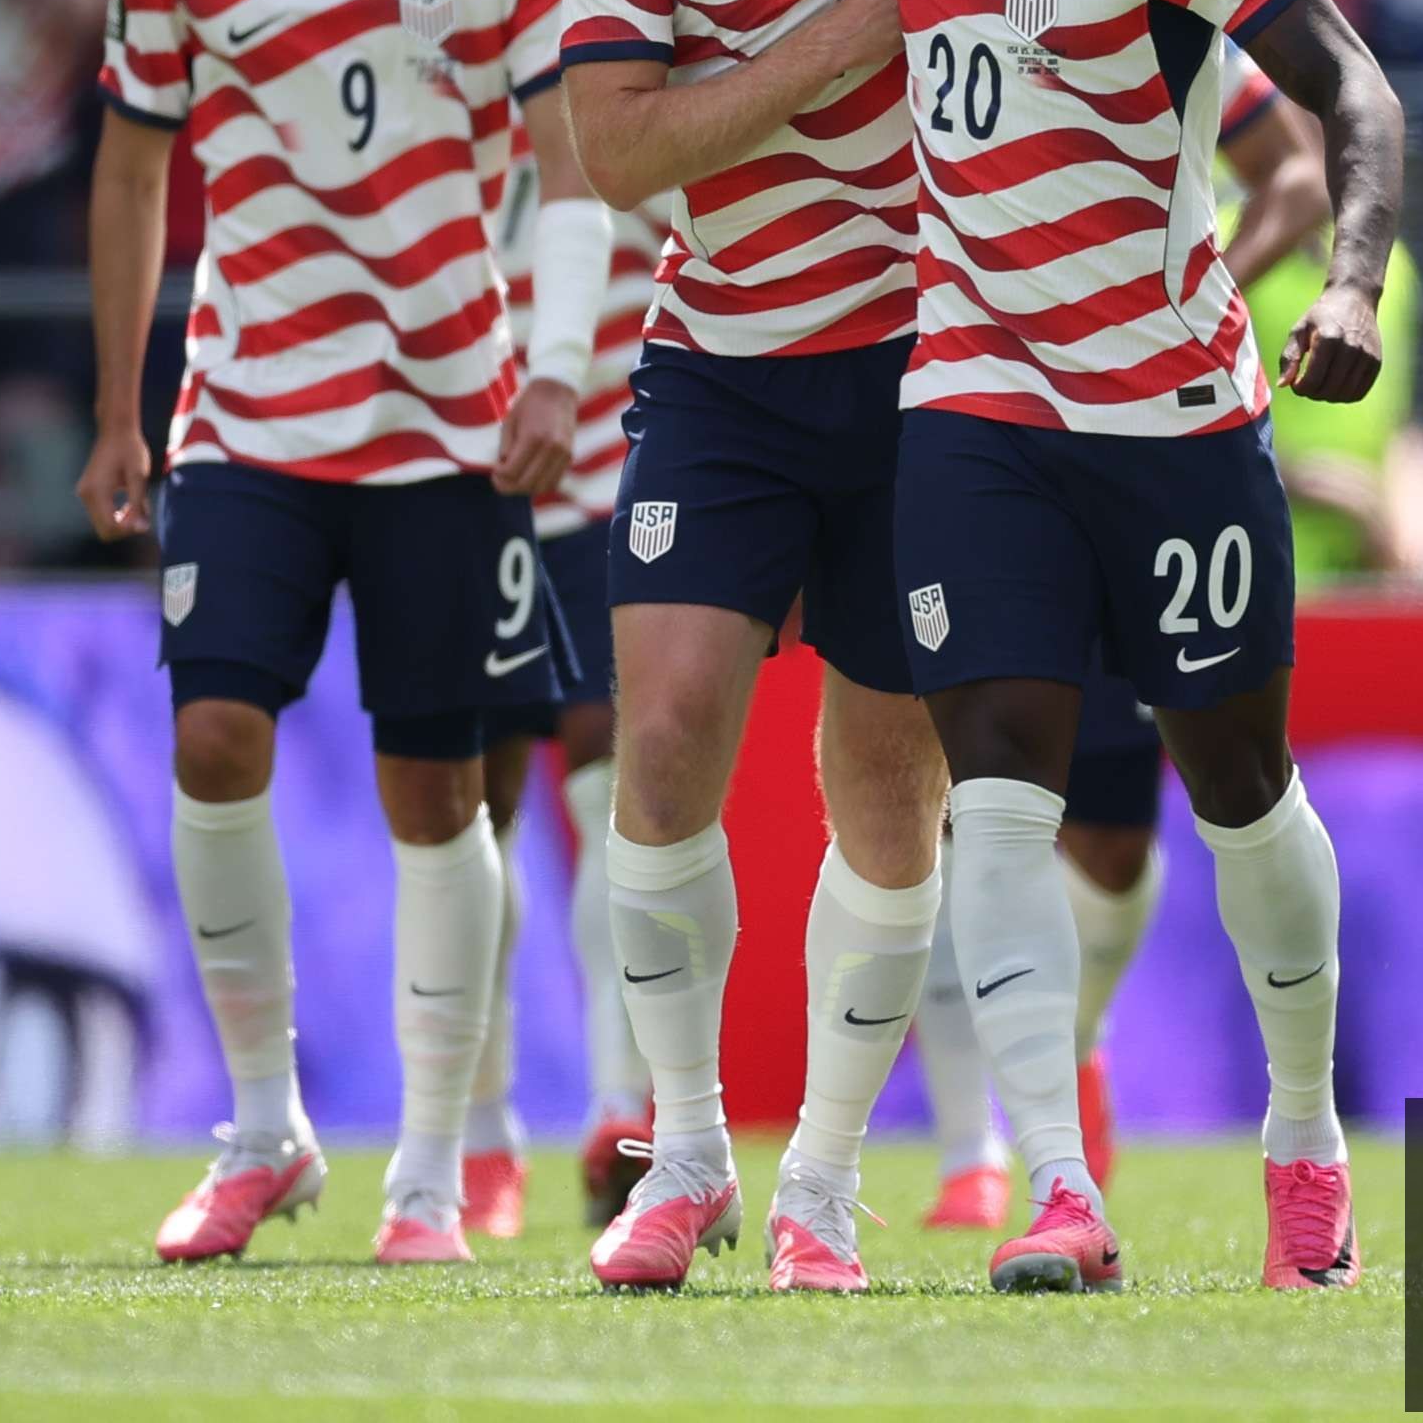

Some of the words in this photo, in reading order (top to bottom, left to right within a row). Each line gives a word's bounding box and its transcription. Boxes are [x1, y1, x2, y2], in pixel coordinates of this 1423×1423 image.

[341, 61, 376, 153] 9
[927, 33, 1002, 141] 20
[635, 505, 674, 528] USA
[494, 535, 536, 640] 9
[911, 588, 941, 616] USA
[1153, 524, 1253, 635] 20
